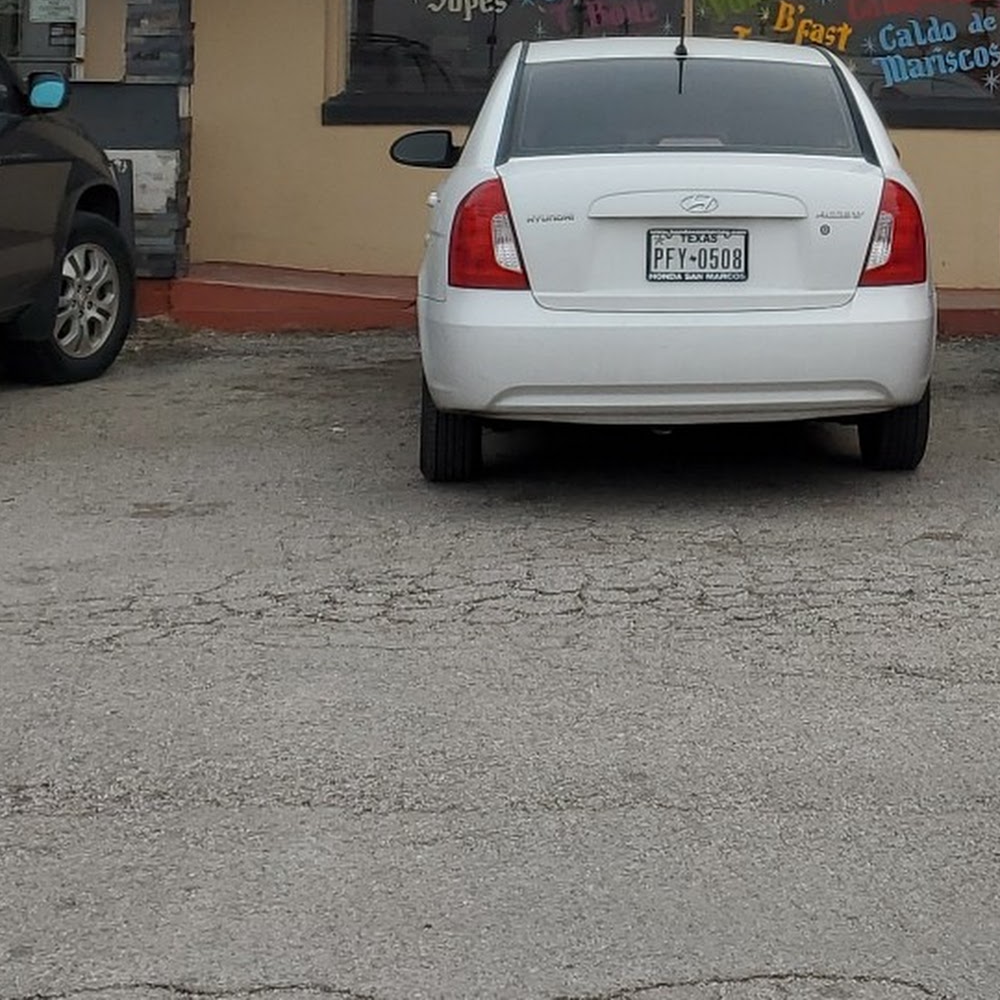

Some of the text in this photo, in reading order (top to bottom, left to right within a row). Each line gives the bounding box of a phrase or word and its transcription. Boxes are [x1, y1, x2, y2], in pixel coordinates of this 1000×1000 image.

[878, 12, 998, 50] Caldo de
[681, 233, 718, 243] TEXAS
[649, 273, 682, 281] HONDA
[684, 273, 704, 281] SAN
